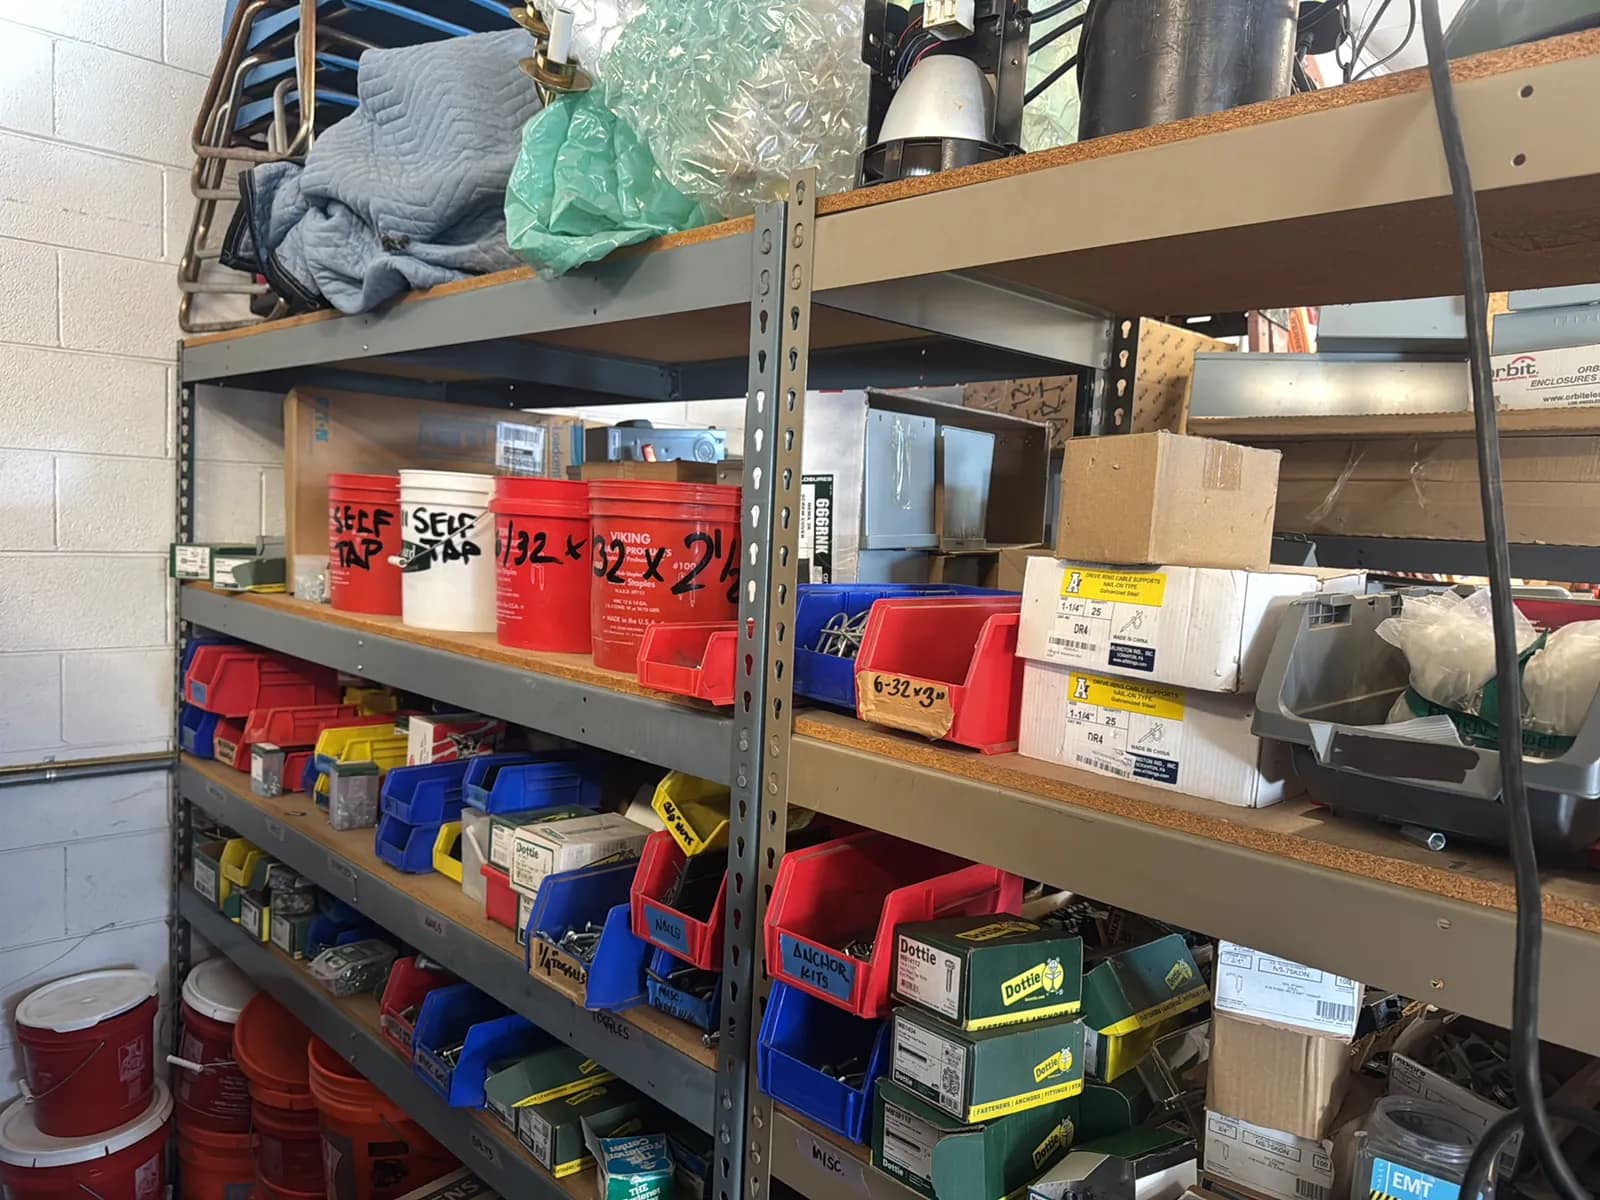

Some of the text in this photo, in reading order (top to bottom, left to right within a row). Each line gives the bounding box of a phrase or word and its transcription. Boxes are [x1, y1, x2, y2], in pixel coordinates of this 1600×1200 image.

[1530, 374, 1597, 387] ENCLOSURES
[1577, 365, 1600, 374] ORB
[334, 505, 394, 538] SELF
[413, 507, 477, 538] SELF
[815, 498, 829, 555] 666RNK
[610, 531, 651, 544] VIKING
[334, 538, 384, 571] TAP
[419, 538, 481, 565] TAP
[1132, 576, 1160, 585] SUPPORTS
[1091, 607, 1102, 616] 25
[1074, 624, 1088, 635] DR4
[1105, 716, 1117, 726] 25
[516, 842, 539, 859] Dottie
[793, 942, 850, 983] ANCHOR
[900, 939, 937, 965] Dottie
[801, 965, 829, 989] KITS
[1005, 972, 1041, 1000] Dottie
[1035, 1057, 1059, 1078] Dottie
[977, 1101, 1011, 1115] FASTENERS
[1015, 1093, 1041, 1106] ANCHORS
[1045, 1086, 1068, 1097] FITTINGS
[812, 1144, 845, 1176] MISC.
[1034, 1133, 1060, 1164] Dottie
[883, 1158, 904, 1176] Dottie
[629, 1183, 649, 1197] THE
[1392, 1172, 1434, 1198] EMT
